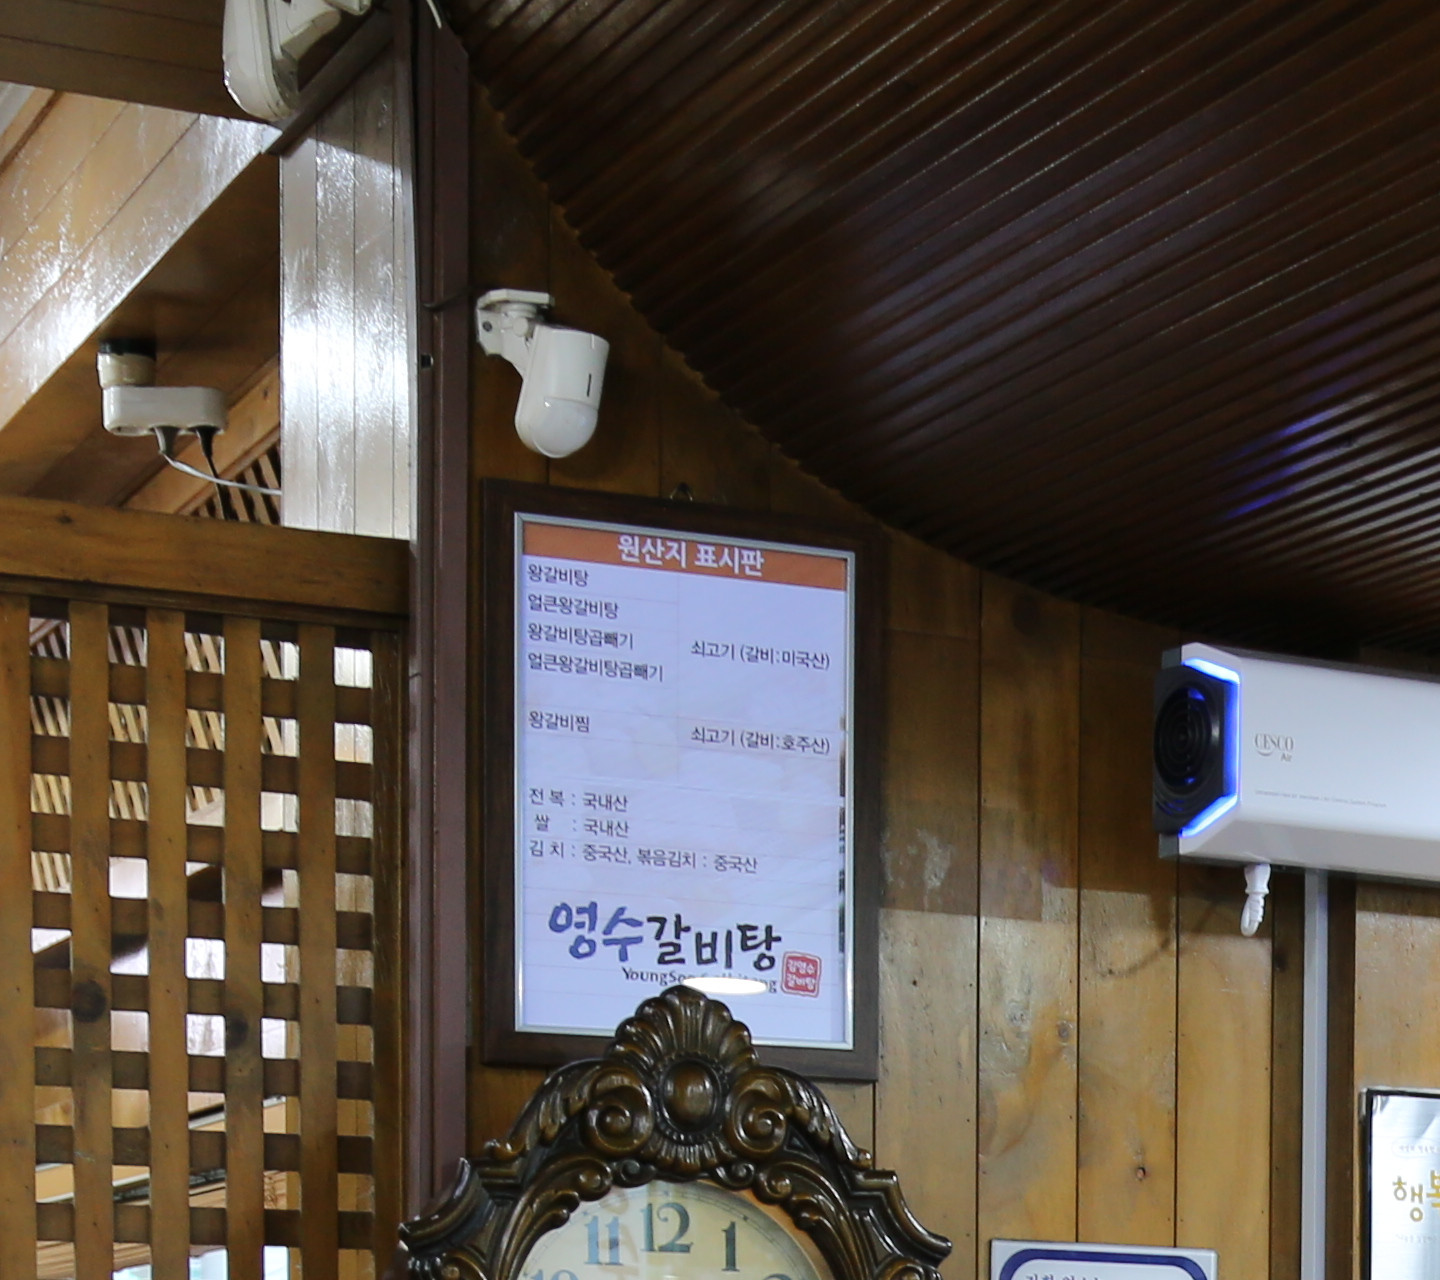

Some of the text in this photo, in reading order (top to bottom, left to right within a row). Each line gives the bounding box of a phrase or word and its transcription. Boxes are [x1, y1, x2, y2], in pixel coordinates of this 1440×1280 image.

[617, 535, 764, 577] 원산지 표시판
[528, 564, 588, 587] 왕갈비탕
[528, 594, 619, 619] 얼큰왕갈비탕
[528, 622, 634, 650] 왕갈비탕곱빼기
[690, 640, 735, 660] 쇠고기
[528, 652, 663, 682] 얼큰왕갈비탕곱빼기
[528, 711, 590, 733] 왕갈비찜
[691, 727, 735, 746] 쇠고기
[1255, 733, 1294, 751] CESCO
[582, 793, 627, 812] 국내산
[534, 813, 628, 838] 쌀 국내산
[637, 847, 696, 869] 볶음김치
[713, 854, 757, 874] 중국산
[549, 901, 781, 971] 영수갈비탕
[584, 1216, 623, 1265] 11
[641, 1202, 694, 1253] 12
[721, 1221, 740, 1272] 1
